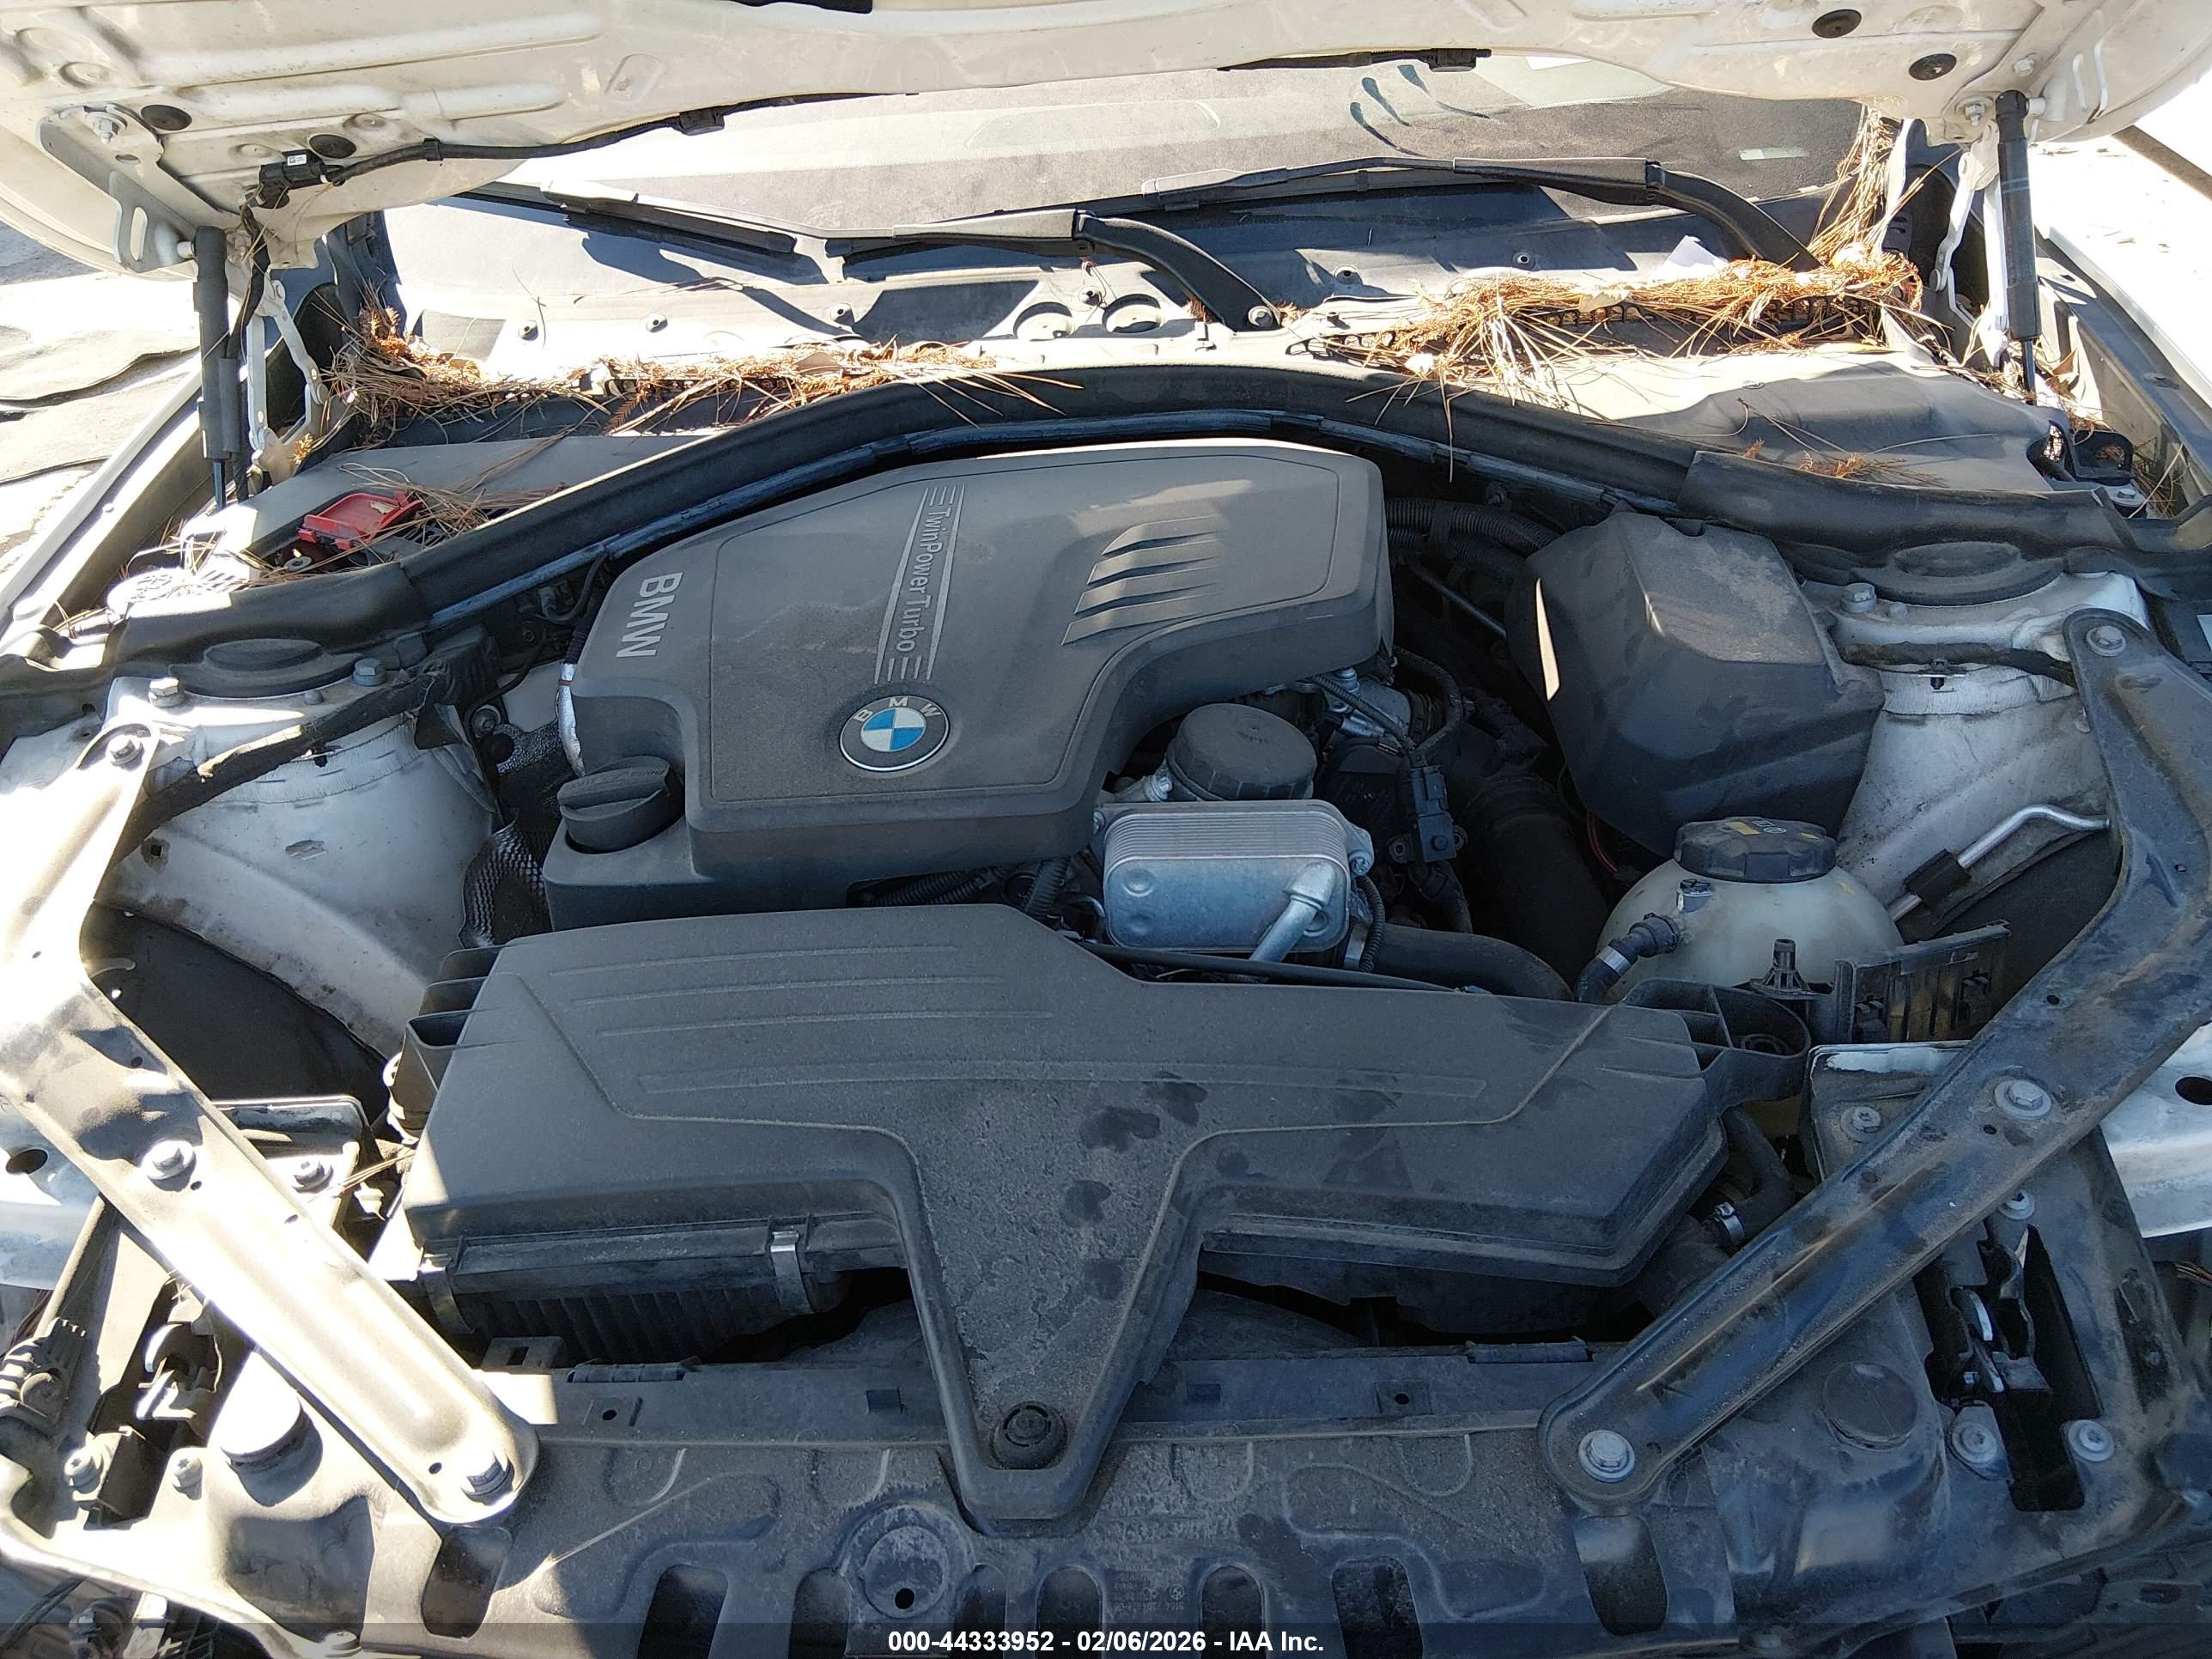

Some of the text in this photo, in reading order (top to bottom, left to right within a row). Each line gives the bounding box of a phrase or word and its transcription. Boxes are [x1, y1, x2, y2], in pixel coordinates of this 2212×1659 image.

[616, 571, 684, 658] BMW
[896, 507, 952, 653] TwinPower Turbo
[853, 696, 942, 722] BMW
